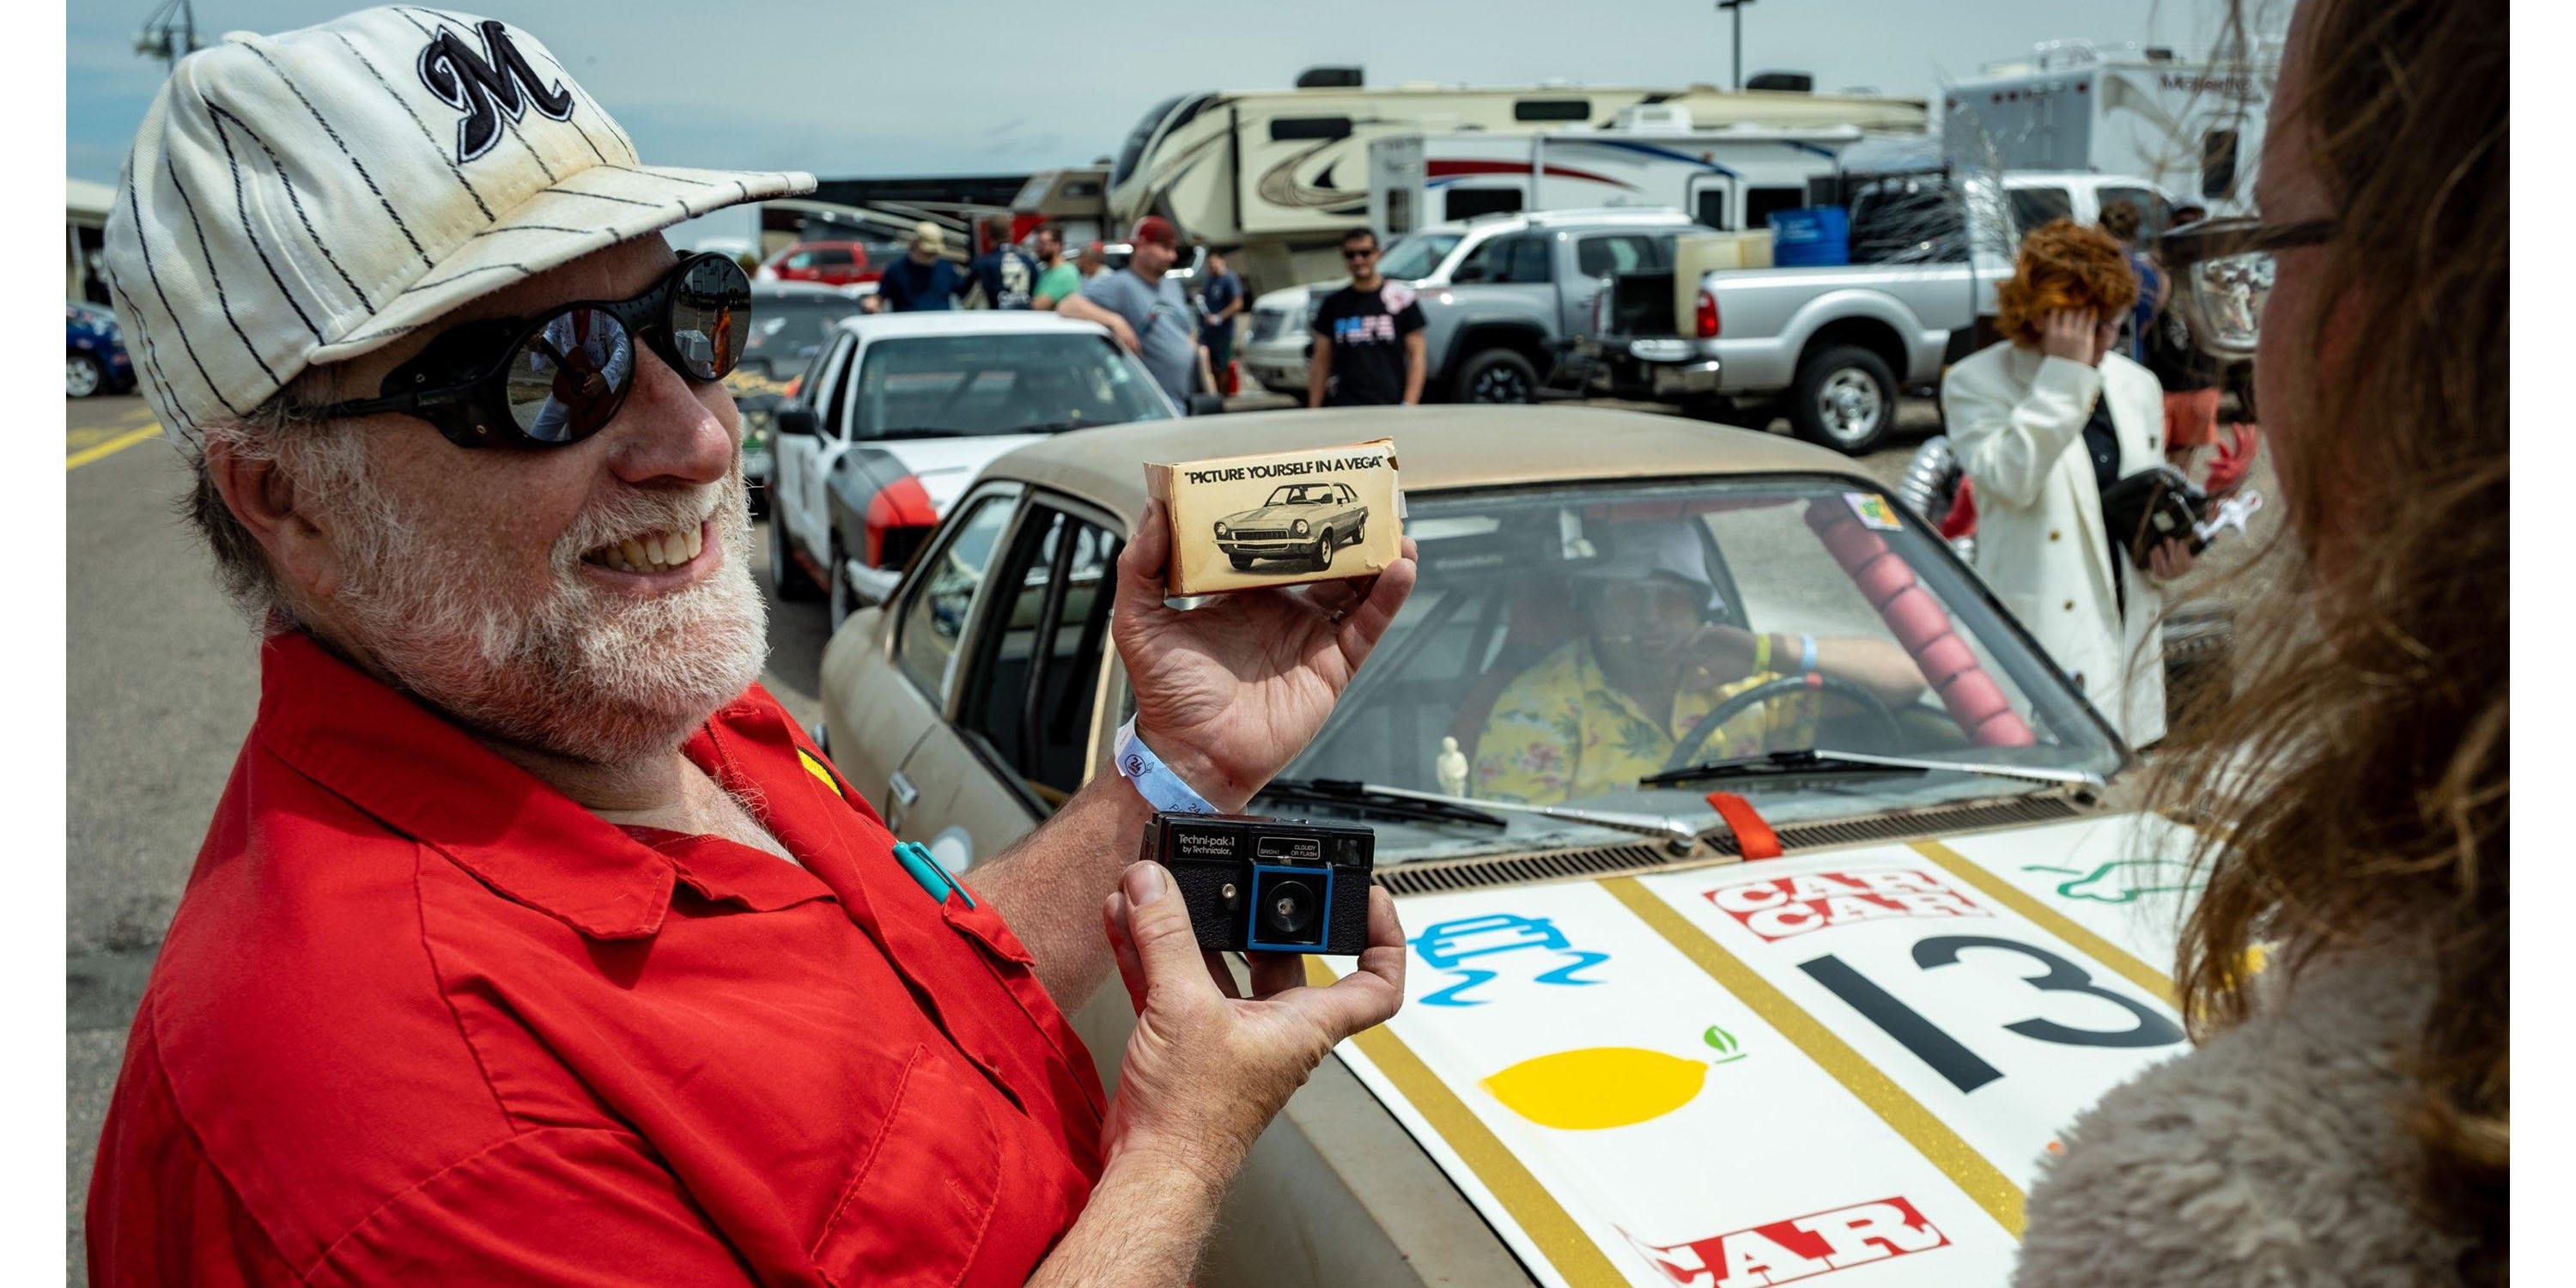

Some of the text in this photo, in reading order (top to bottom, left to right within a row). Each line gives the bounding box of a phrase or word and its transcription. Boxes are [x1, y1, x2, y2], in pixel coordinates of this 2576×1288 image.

[417, 21, 575, 165] M
[1184, 455, 1383, 484] "PICTURE YOURSELF IN A VEGA"
[1182, 846, 1192, 854] by
[1713, 869, 1959, 912] CAR
[1747, 892, 1994, 939] CAR
[1795, 935, 2187, 1095] 13
